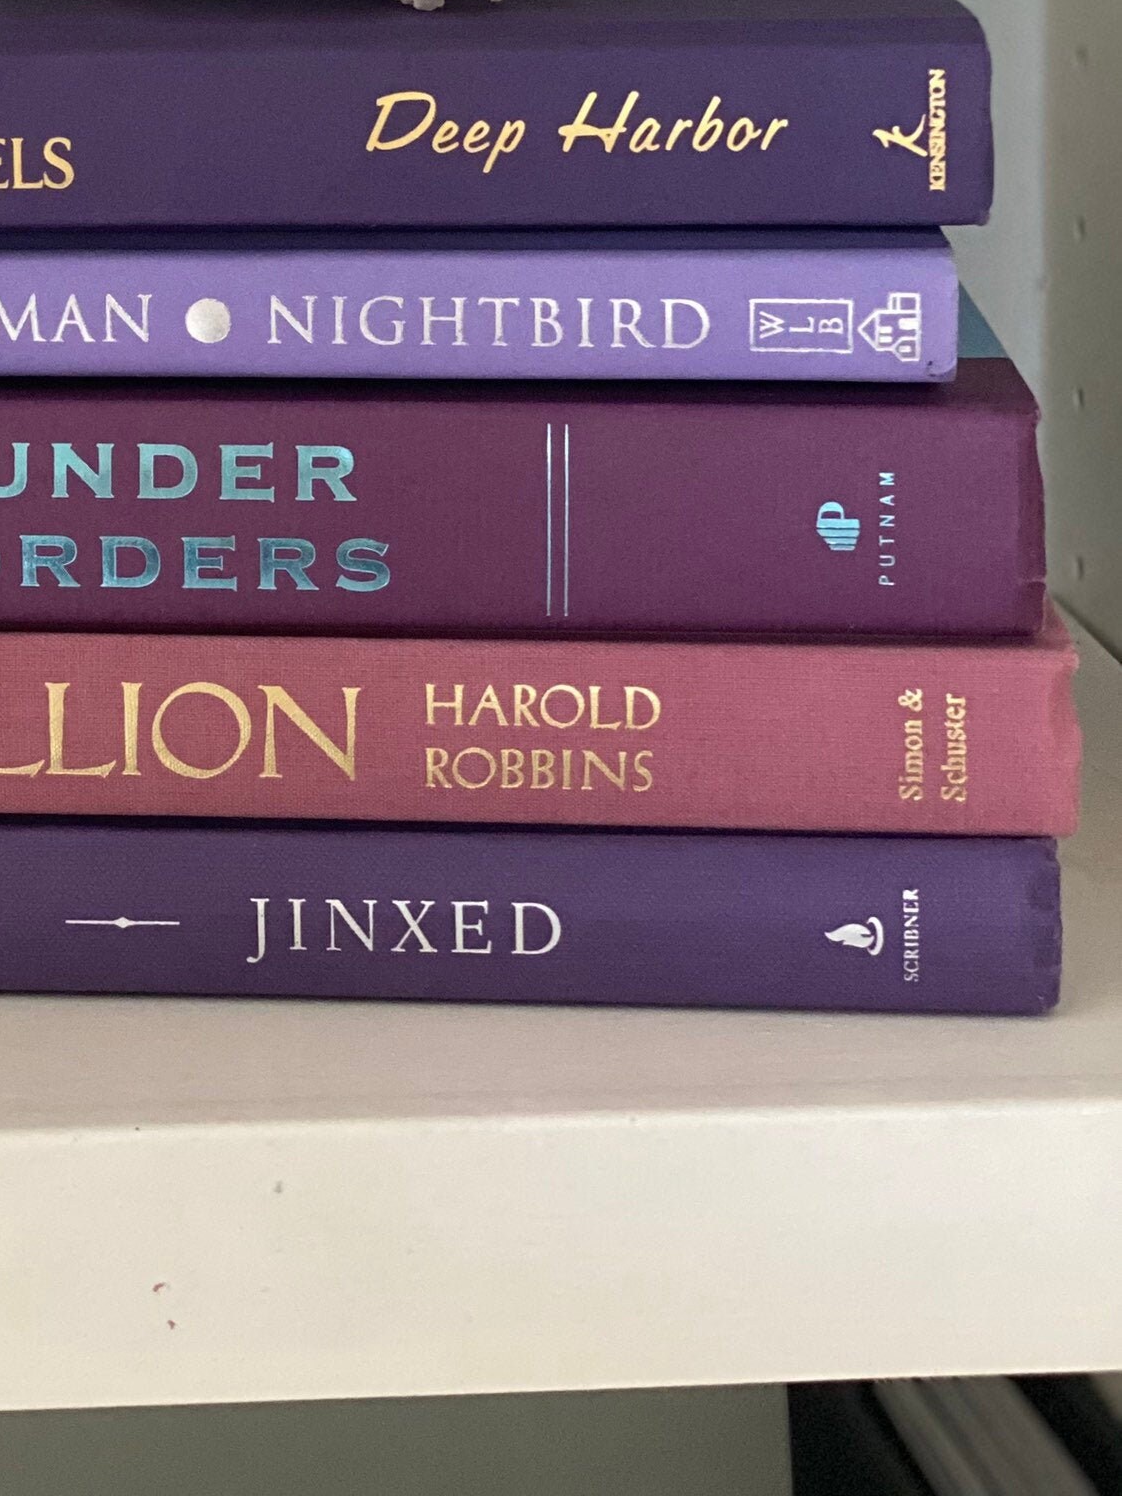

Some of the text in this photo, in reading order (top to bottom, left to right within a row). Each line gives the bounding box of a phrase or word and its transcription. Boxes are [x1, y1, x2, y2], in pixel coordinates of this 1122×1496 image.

[365, 90, 789, 174] Deep Harbor
[928, 68, 947, 192] KENSINGTON
[267, 294, 711, 349] NIGHTBIRD
[878, 472, 896, 586] PUTNAM
[425, 683, 661, 731] HAROLD
[897, 688, 924, 801] Simon &
[940, 692, 968, 803] Schuster
[425, 746, 654, 791] ROBBINS
[246, 897, 562, 964] JINXED
[902, 888, 920, 981] SCRIBNER
